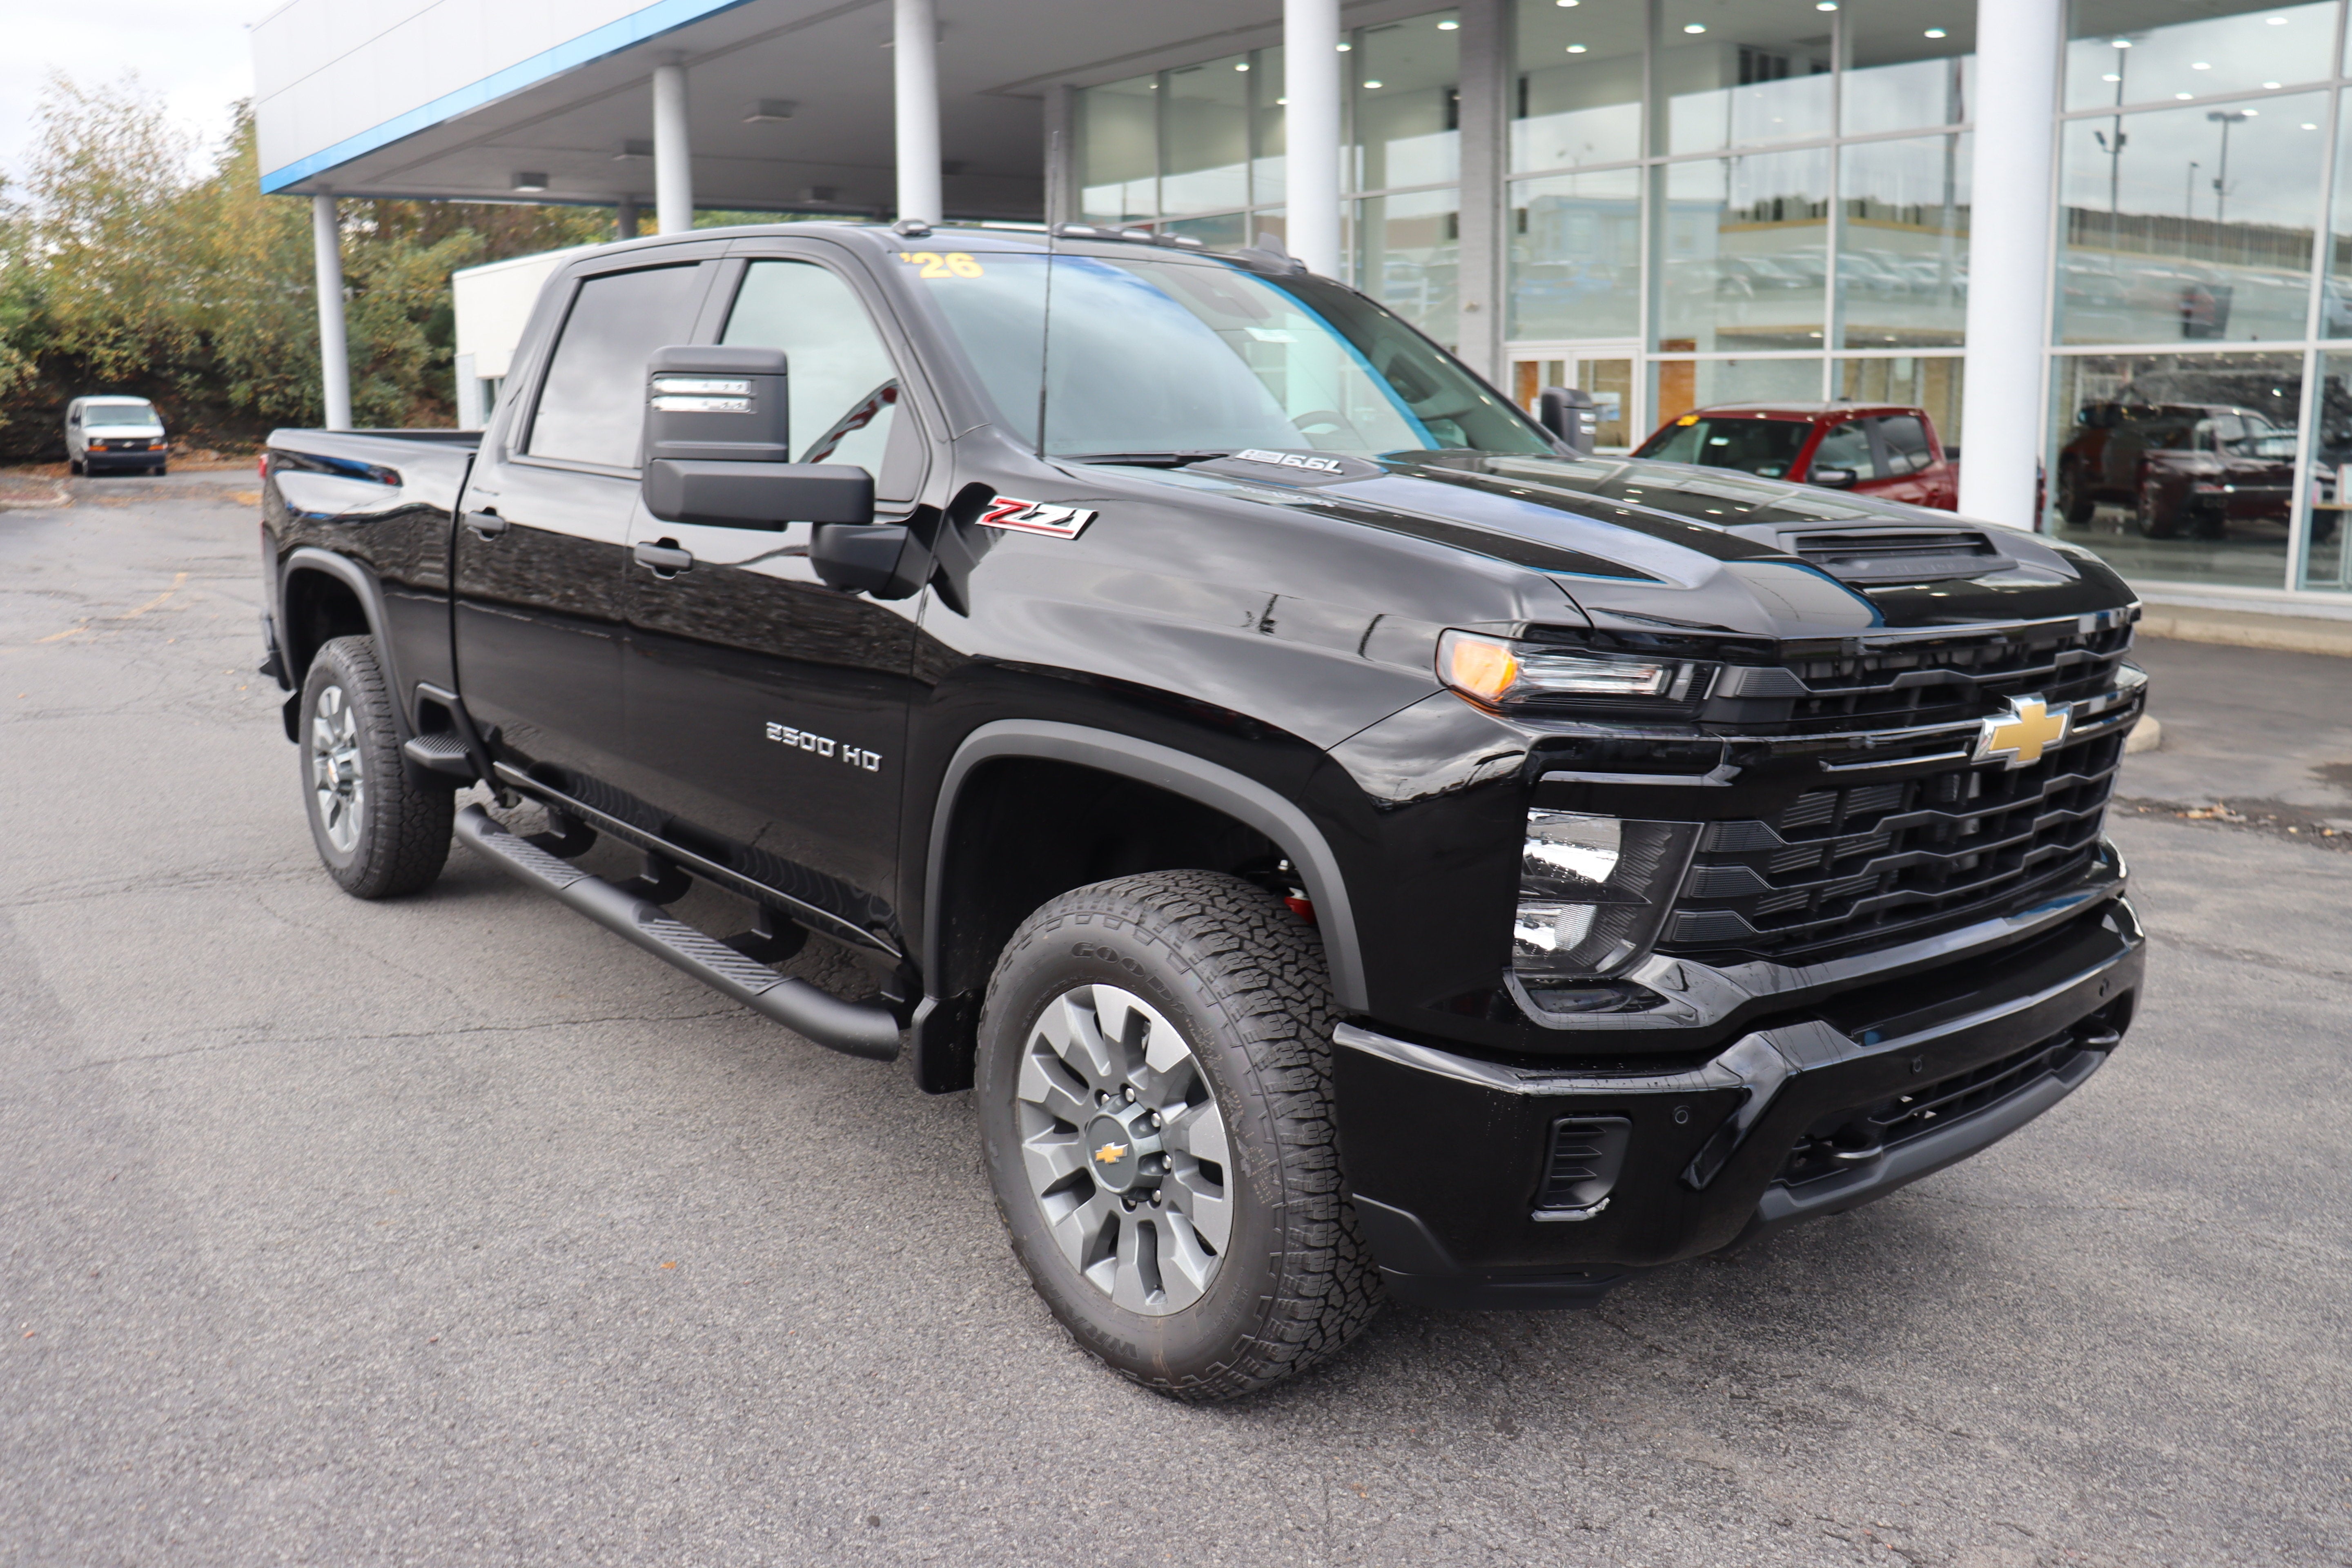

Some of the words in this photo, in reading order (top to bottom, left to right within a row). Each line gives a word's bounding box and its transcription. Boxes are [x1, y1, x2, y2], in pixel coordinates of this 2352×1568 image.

[899, 252, 984, 278] '26
[975, 494, 1098, 540] Z71
[766, 721, 837, 757] 2500
[842, 744, 882, 772] HD
